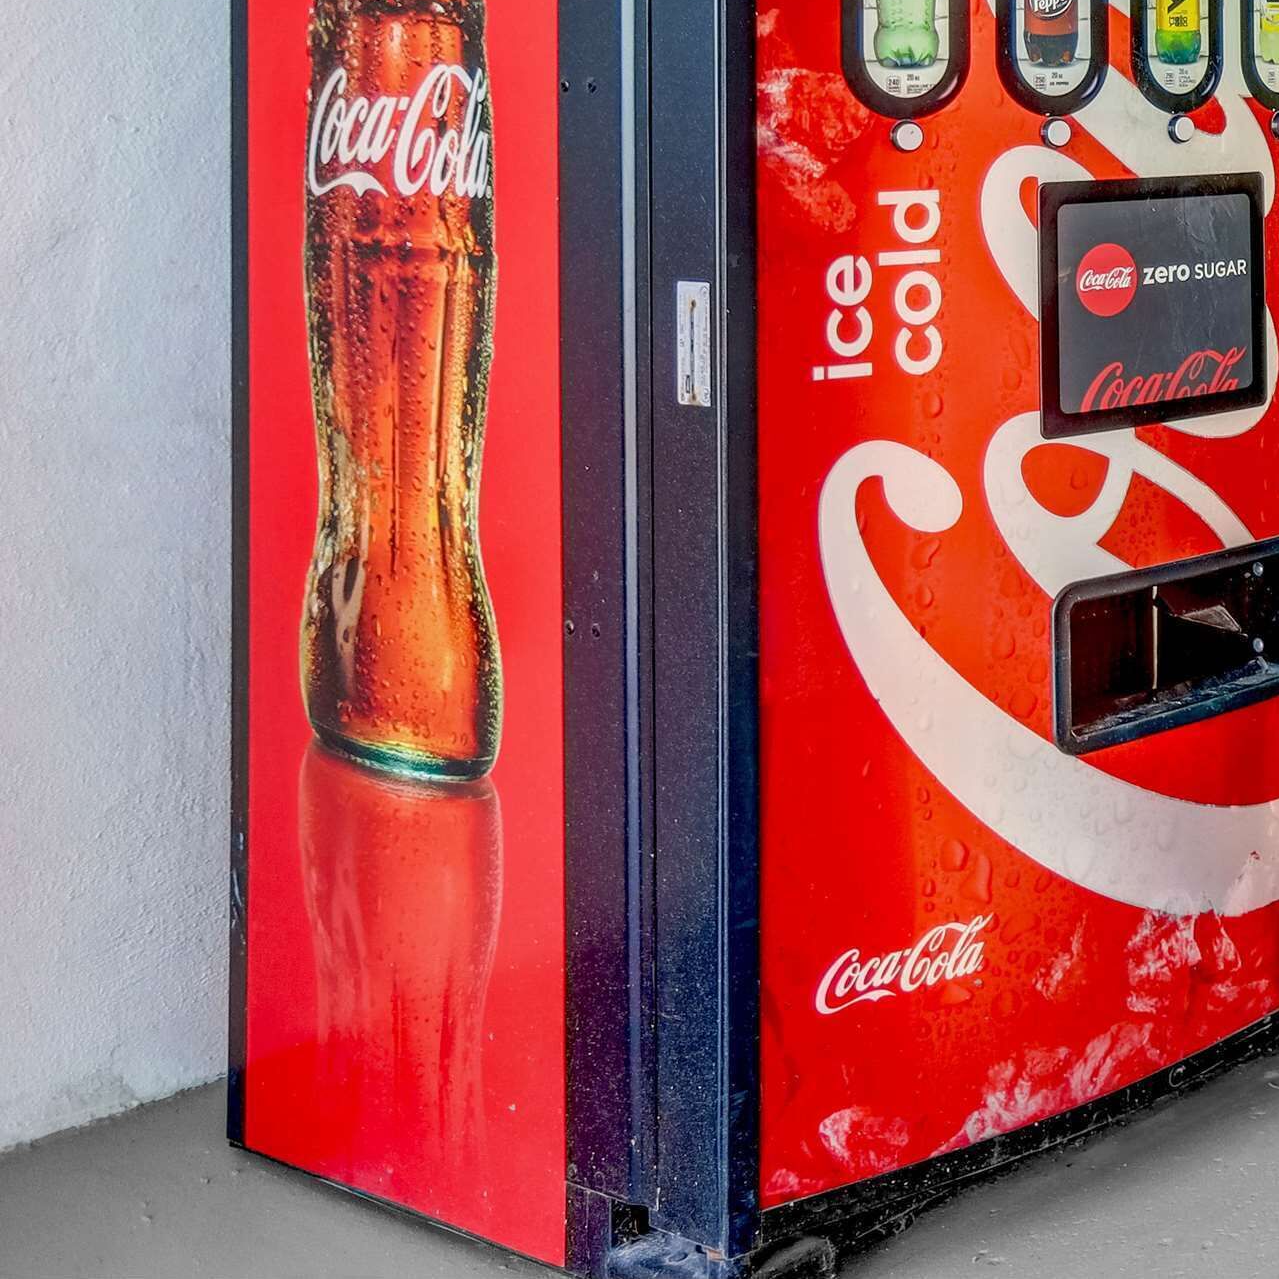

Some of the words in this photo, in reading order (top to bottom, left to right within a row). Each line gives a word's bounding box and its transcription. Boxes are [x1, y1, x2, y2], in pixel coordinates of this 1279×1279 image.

[308, 64, 490, 198] Coca-Cola
[812, 254, 873, 382] ice
[877, 189, 943, 376] cold
[1080, 267, 1135, 292] Coca-Cola
[1143, 265, 1191, 286] zero
[1194, 259, 1247, 281] SUGAR
[815, 912, 994, 1015] Coca-Cola
